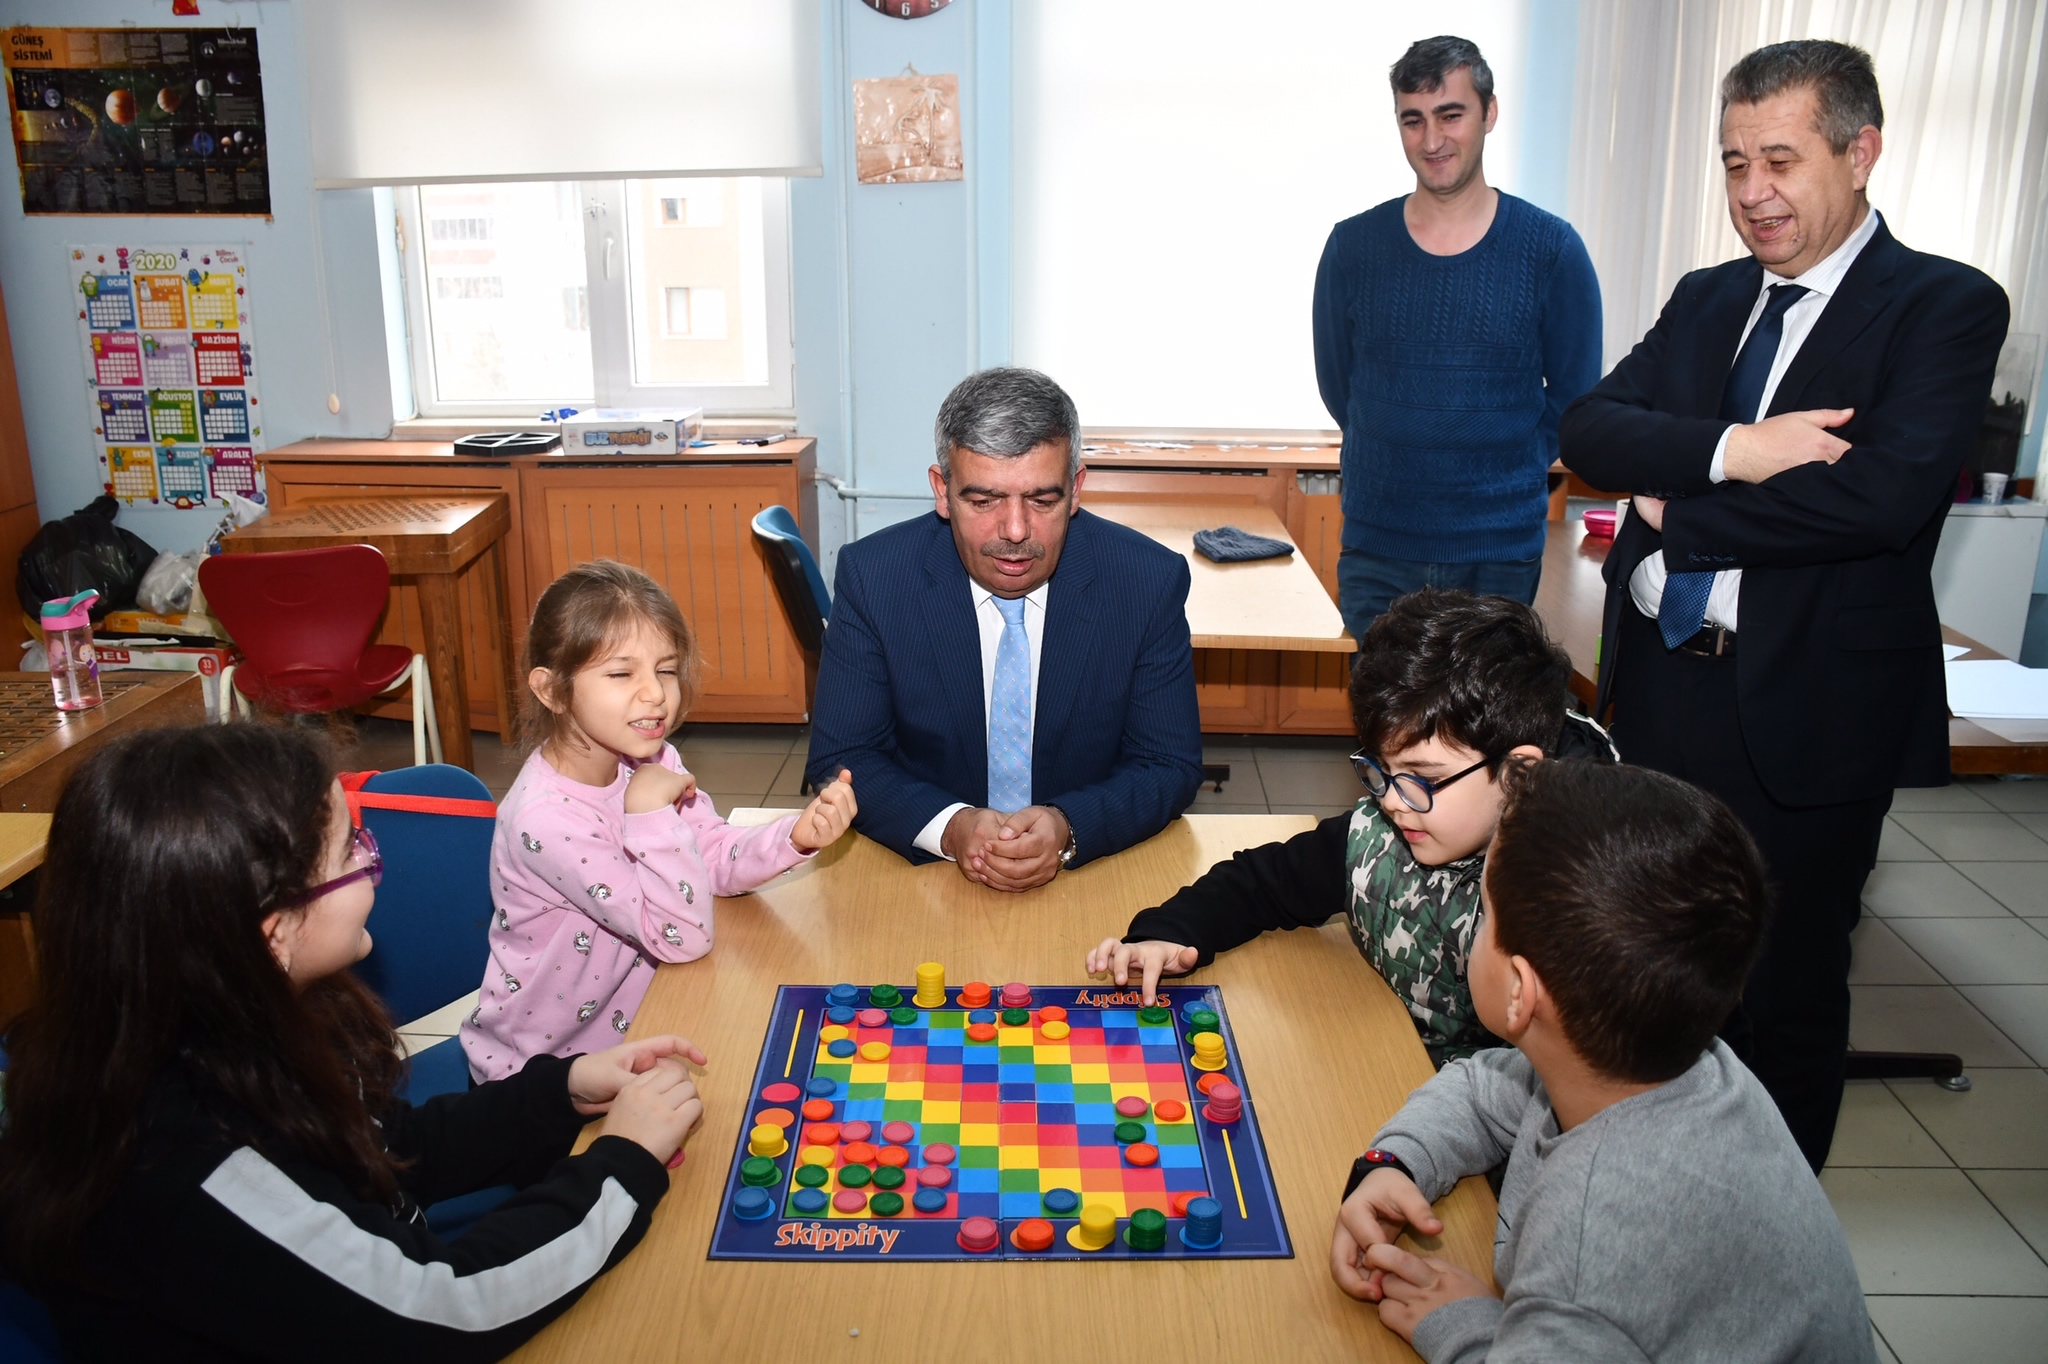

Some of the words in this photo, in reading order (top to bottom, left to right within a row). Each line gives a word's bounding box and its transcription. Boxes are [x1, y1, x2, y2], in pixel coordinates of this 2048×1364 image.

[901, 2, 910, 16] 6
[11, 33, 44, 48] GÜNEŞ
[13, 48, 53, 61] SİSTEMİ
[135, 253, 176, 270] 2020
[107, 278, 129, 287] OCAK
[154, 278, 180, 288] ŞUBAT
[201, 334, 238, 345] HAZİRAN
[111, 392, 142, 401] TEMMUZ
[157, 391, 193, 401] AĞUSTOS
[219, 392, 244, 401] EYLÜL
[222, 450, 251, 459] ARALIK
[94, 650, 129, 662] SEL
[202, 658, 212, 669] 33
[1075, 989, 1171, 1009] Sippity
[774, 1222, 901, 1254] Skippity
